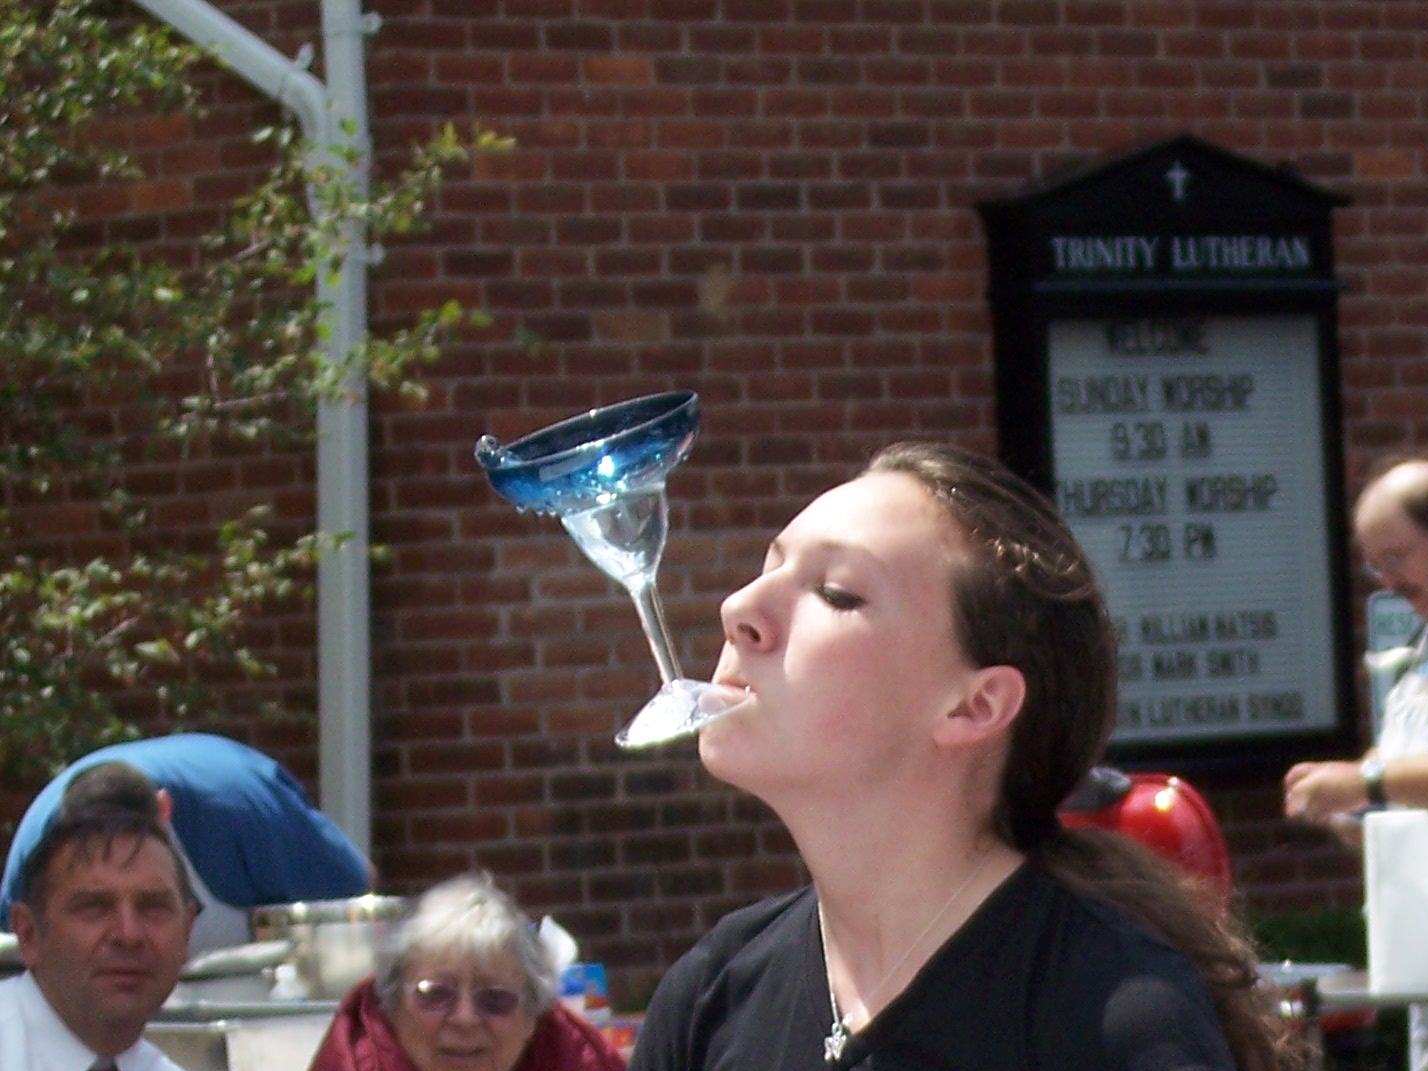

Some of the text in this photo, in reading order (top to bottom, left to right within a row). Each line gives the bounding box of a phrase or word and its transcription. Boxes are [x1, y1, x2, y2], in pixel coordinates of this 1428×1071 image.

[1050, 234, 1311, 269] TRINITY LUTHERAN
[1056, 372, 1255, 414] SUNDAY WORSHIP
[1184, 473, 1278, 513] WORSHIP
[1184, 520, 1217, 560] PM
